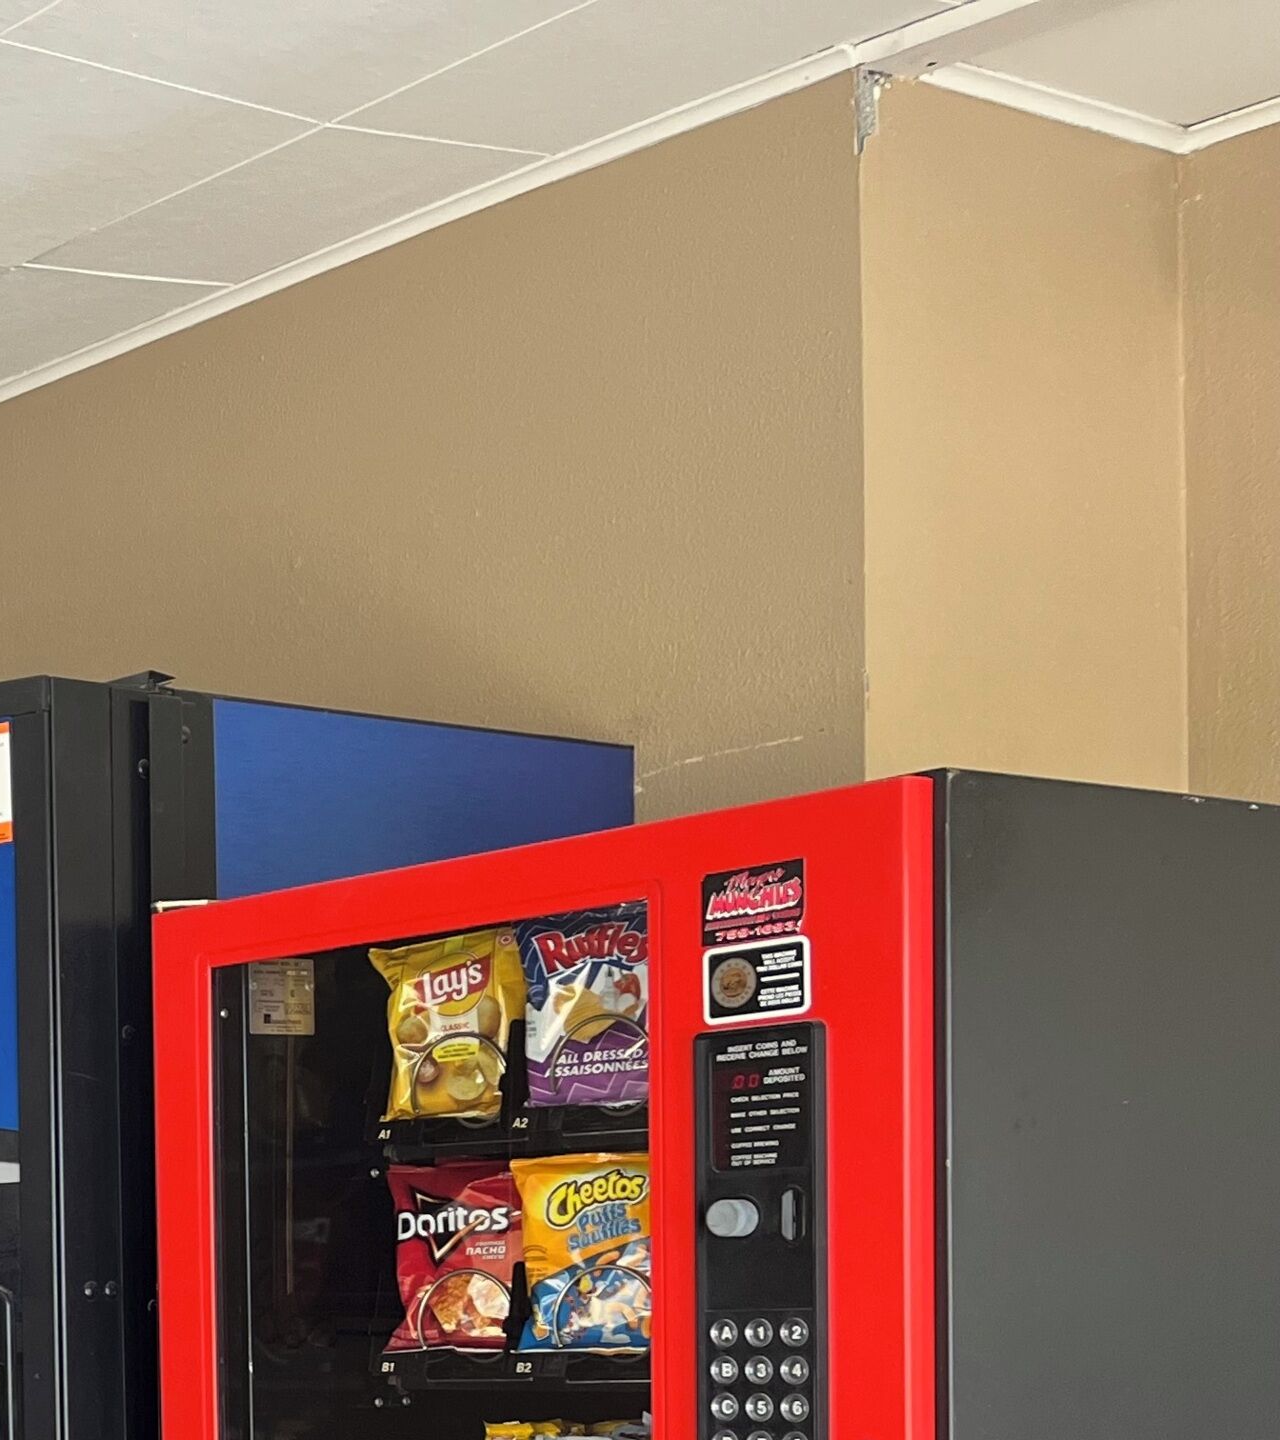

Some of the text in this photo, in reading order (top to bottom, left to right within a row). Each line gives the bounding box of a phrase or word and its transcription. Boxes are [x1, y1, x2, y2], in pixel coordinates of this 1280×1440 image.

[534, 922, 648, 976] Ruffles
[422, 960, 483, 1007] Lay's
[727, 1039, 797, 1053] INSERT COINS AND
[556, 1054, 579, 1065] ALL
[716, 1046, 808, 1062] RECEIVE CHANGE BELOW
[768, 1066, 800, 1076] AMOUNT
[763, 1073, 806, 1084] DEPOSITED
[513, 1117, 529, 1128] A2
[378, 1129, 391, 1139] A1
[547, 1169, 646, 1227] Cheetos
[397, 1207, 509, 1241] Doritos
[576, 1203, 627, 1233] Puffs
[466, 1245, 506, 1256] NACHO
[721, 1325, 802, 1340] A 1 2
[381, 1362, 395, 1372] B1
[516, 1362, 532, 1373] B2
[721, 1363, 802, 1378] B 3 4
[721, 1400, 803, 1415] C 5 6
